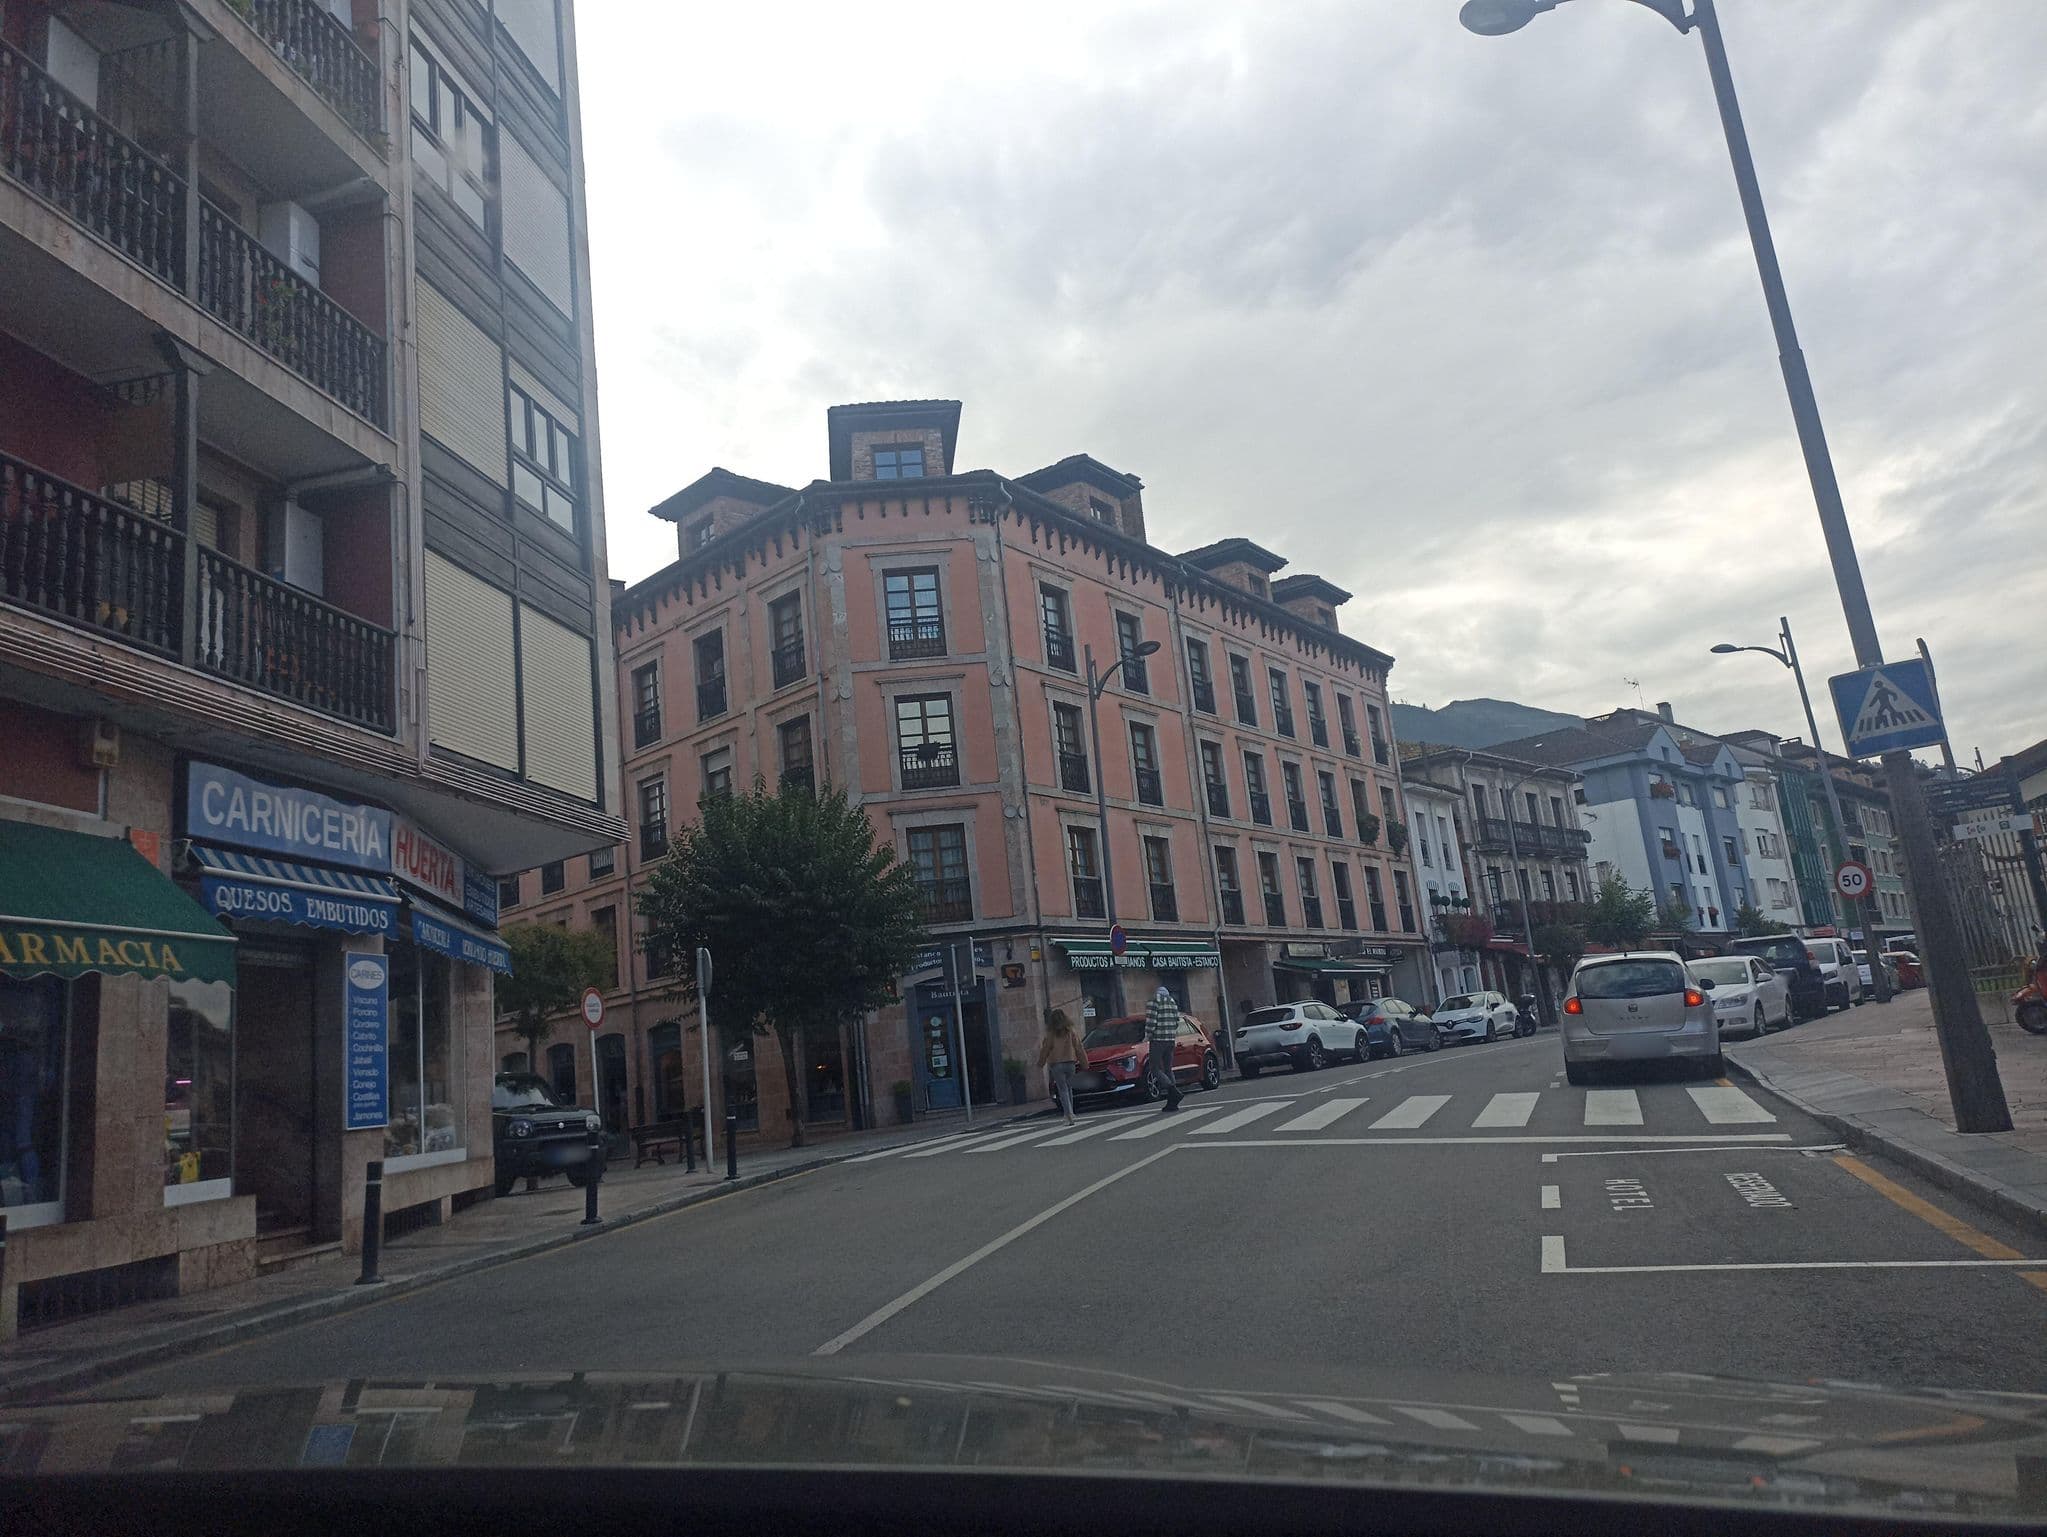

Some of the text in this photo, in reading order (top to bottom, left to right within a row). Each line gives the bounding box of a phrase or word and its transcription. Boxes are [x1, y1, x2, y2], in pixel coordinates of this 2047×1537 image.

[202, 781, 382, 859] CARNICERÍA
[396, 825, 455, 895] HUERTA
[1842, 874, 1862, 887] 50
[215, 886, 389, 929] QUESOS EMBUTIDOS
[1071, 956, 1146, 968] PRODUCTOS AIANOS
[1152, 956, 1167, 968] CASA
[351, 968, 383, 980] CARNES
[931, 990, 969, 999] Bautita
[1604, 1178, 1654, 1210] HOTEL
